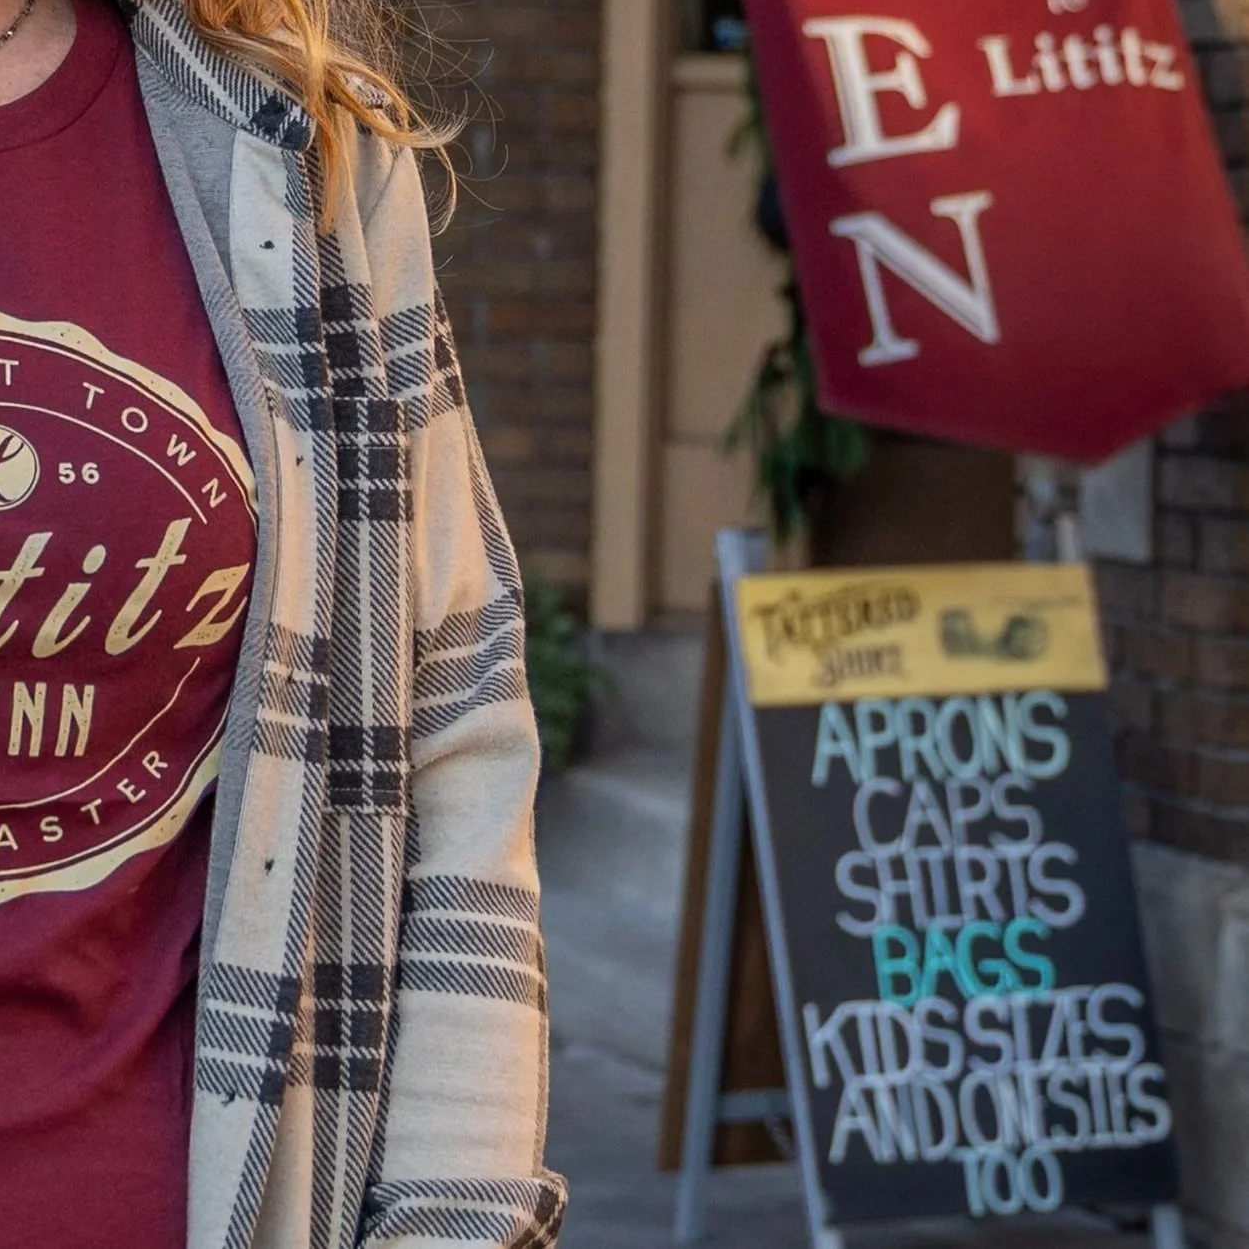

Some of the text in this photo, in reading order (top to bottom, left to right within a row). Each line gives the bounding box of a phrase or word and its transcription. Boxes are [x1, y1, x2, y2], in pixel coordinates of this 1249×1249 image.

[976, 24, 1185, 97] Lititz
[84, 382, 228, 508] TOWN
[811, 691, 1071, 787] APRONS
[852, 772, 1043, 855] CAPS
[835, 842, 1086, 937] SHIRTS
[871, 918, 1057, 1009] BAGS
[802, 995, 964, 1090] KIDS
[949, 1145, 1064, 1217] TOO
